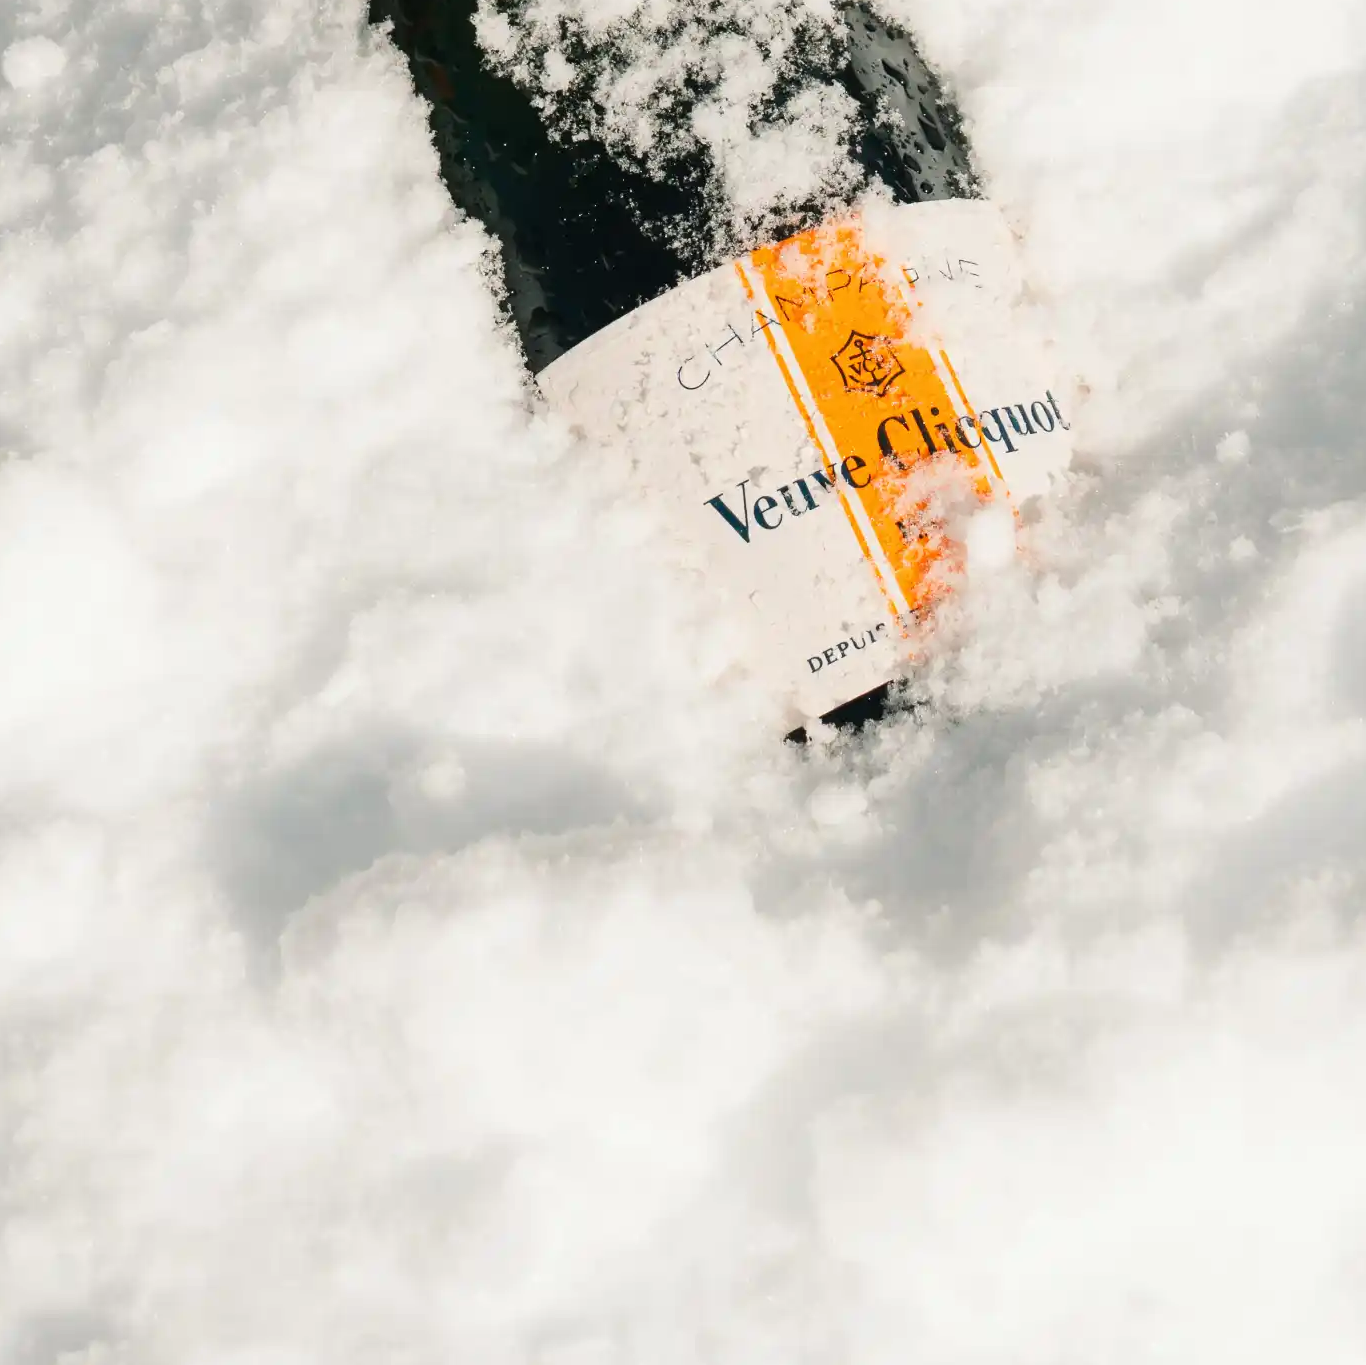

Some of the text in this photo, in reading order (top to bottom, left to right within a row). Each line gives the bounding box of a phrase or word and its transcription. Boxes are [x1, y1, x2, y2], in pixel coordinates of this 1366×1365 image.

[677, 257, 982, 390] CHAMPNE
[703, 389, 1071, 544] Veuve Clicquot
